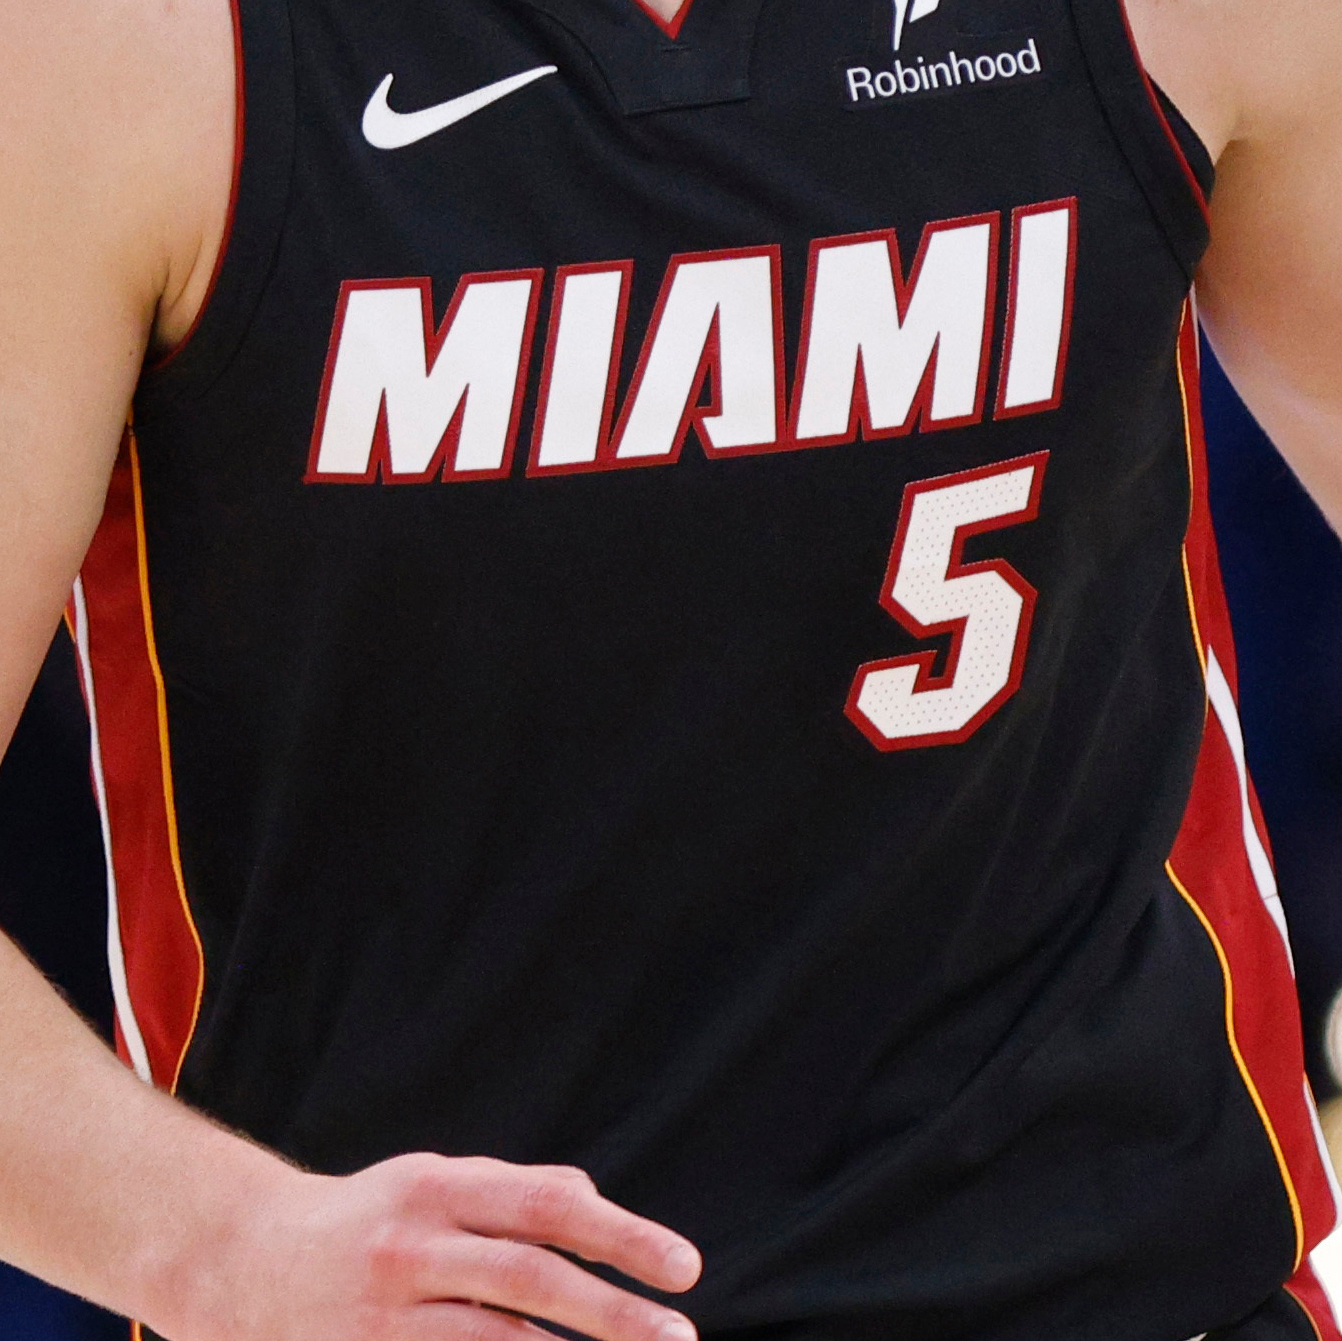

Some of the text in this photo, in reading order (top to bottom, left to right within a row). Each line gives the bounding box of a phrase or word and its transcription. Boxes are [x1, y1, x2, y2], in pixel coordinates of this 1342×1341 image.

[846, 38, 1041, 102] Robinhood
[302, 196, 1077, 485] MIAMI
[843, 450, 1050, 752] 5
